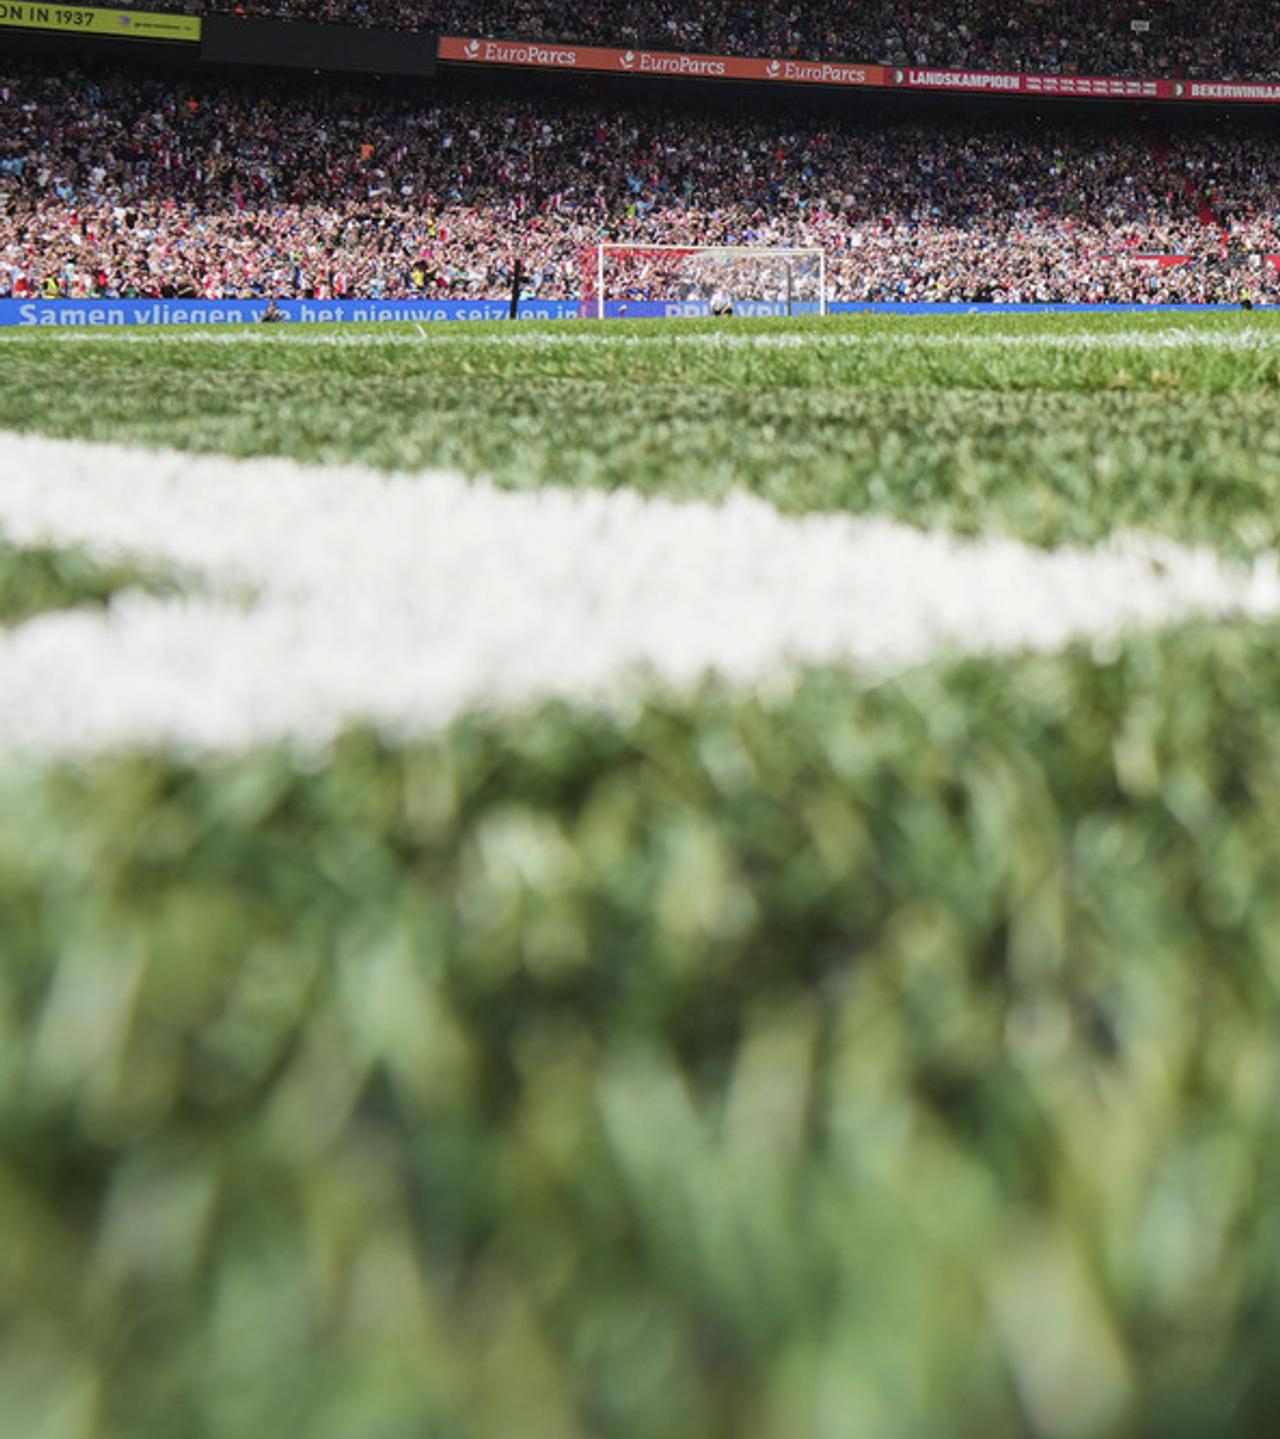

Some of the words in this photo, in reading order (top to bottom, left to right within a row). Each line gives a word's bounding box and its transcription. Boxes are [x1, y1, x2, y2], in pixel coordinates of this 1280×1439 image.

[30, 6, 49, 22] IN
[55, 10, 95, 27] 1937
[485, 43, 576, 64] EuroParcs
[640, 53, 725, 75] EuroParcs
[784, 62, 866, 82] EuroParcs
[909, 71, 1020, 90] LANDSKAMPIOEN
[19, 304, 125, 325] Samen
[134, 303, 242, 324] vliegen
[301, 305, 344, 322] het
[353, 305, 447, 322] nieuwe
[455, 305, 549, 321] seizen
